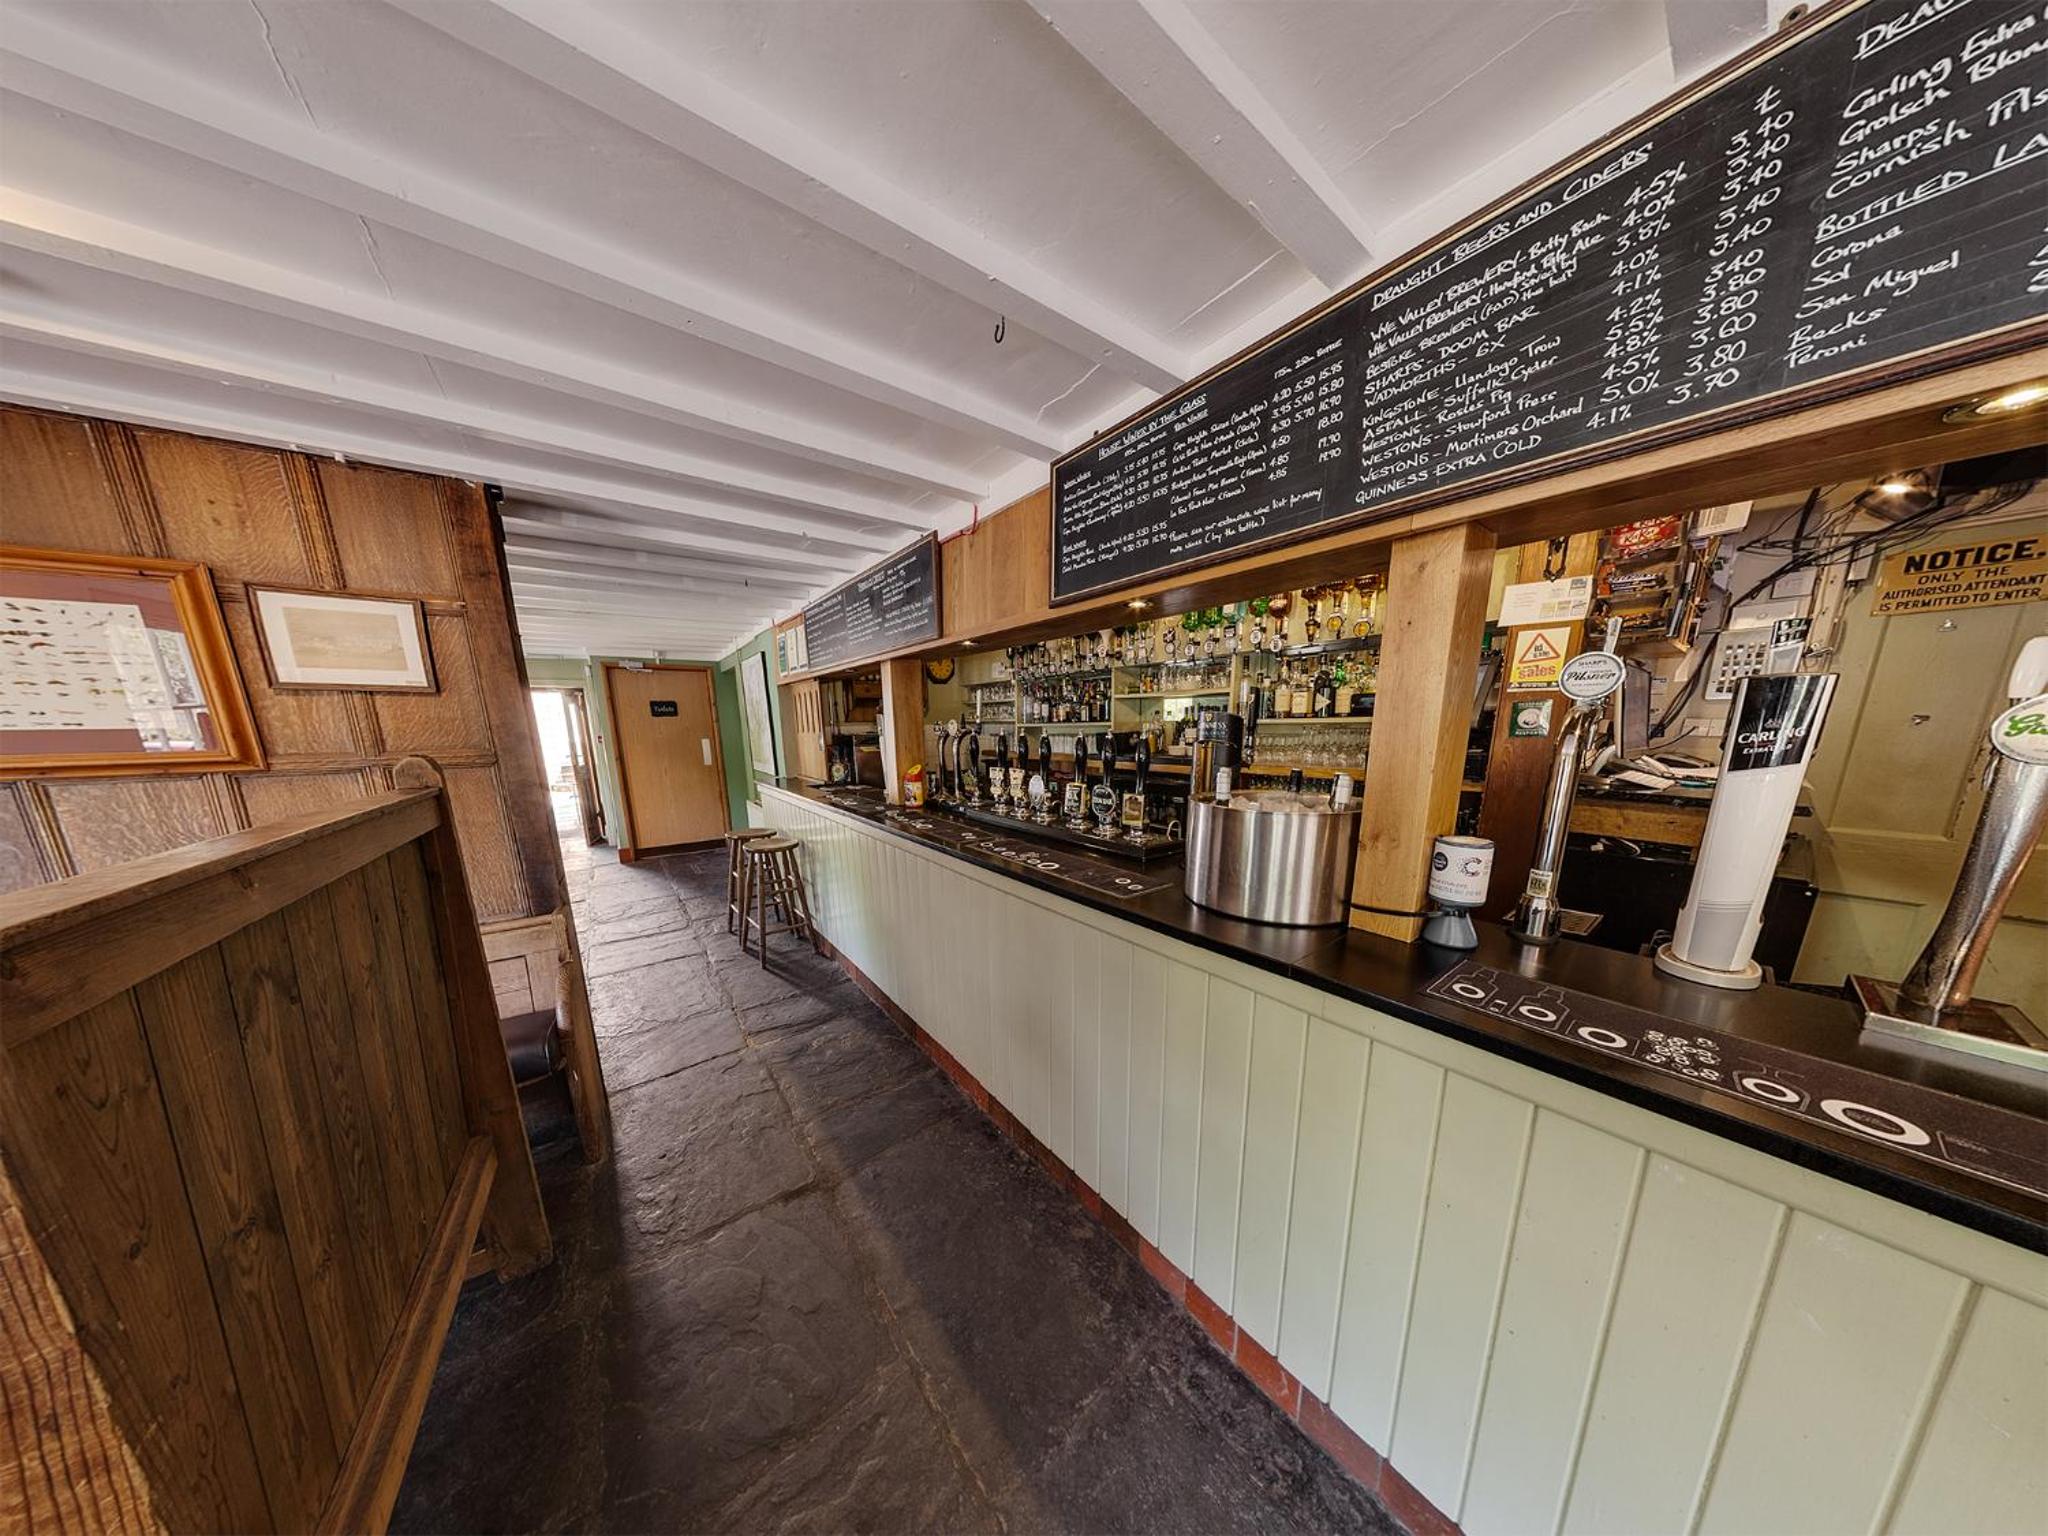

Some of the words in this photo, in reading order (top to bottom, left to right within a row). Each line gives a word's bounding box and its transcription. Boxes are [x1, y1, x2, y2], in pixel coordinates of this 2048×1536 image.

[1843, 57, 1953, 118] Carling
[1959, 15, 2036, 63] Extra
[1831, 118, 1942, 177] Sharps
[1838, 88, 1952, 146] Grolsch
[1825, 119, 1973, 199] Cornish
[1370, 320, 1397, 341] WYE
[1398, 292, 1444, 325] VALLEY
[1623, 160, 1687, 206] 4.5%
[1726, 110, 1794, 155] 3.40
[1373, 256, 1447, 309] DRAUGHT
[1452, 222, 1511, 262] BEERS
[1515, 202, 1553, 227] AND
[1563, 142, 1653, 201] CIDERS
[1612, 213, 1670, 256] 3.8%
[1720, 159, 1782, 201] 3.40
[1622, 188, 1675, 226] 4.0%
[1815, 171, 1969, 240] BOTTLED
[1804, 262, 1852, 292] Sol
[1810, 225, 1903, 268] Corona
[1364, 358, 1456, 407] WADWORTHS
[1611, 264, 1662, 296] 4.1%
[1709, 217, 1772, 257] 3.40
[1438, 328, 1489, 359] DOOM
[1495, 305, 1540, 332] BAR
[1609, 244, 1659, 277] 4.0%
[1604, 306, 1664, 341] 5.5%
[1699, 268, 1767, 302] 3.80
[1795, 294, 1857, 319] San
[1863, 249, 1960, 297] Miguel
[1362, 387, 1440, 428] KINGSTONE
[1606, 287, 1661, 321] 4.2%
[1603, 328, 1662, 358] 4.8%
[1693, 290, 1759, 325] 3.80
[1783, 334, 1867, 369] Peroni
[1787, 308, 1887, 351] Becks
[1361, 434, 1433, 467] WESTONS
[1600, 346, 1660, 380] 4.5%
[1688, 312, 1757, 349] 3.60
[1521, 396, 1584, 432] Orchard
[1600, 369, 1660, 402] 5.0%
[1683, 340, 1746, 377] 3.80
[1355, 470, 1429, 504] GUINNESS
[1494, 434, 1542, 460] COLD
[1586, 404, 1632, 428] 4.1%
[1666, 368, 1740, 405] 3.70
[1879, 602, 1890, 611] IS
[1895, 595, 1969, 610] PERMITTED
[1972, 593, 1990, 603] TO
[1994, 587, 2041, 601] ENTER
[1882, 583, 1962, 600] AUTHORISED
[1963, 574, 2048, 592] ATTENDANT
[1918, 571, 1965, 585] ONLY
[1975, 566, 2012, 578] THE
[1566, 671, 1616, 682] Pilsner
